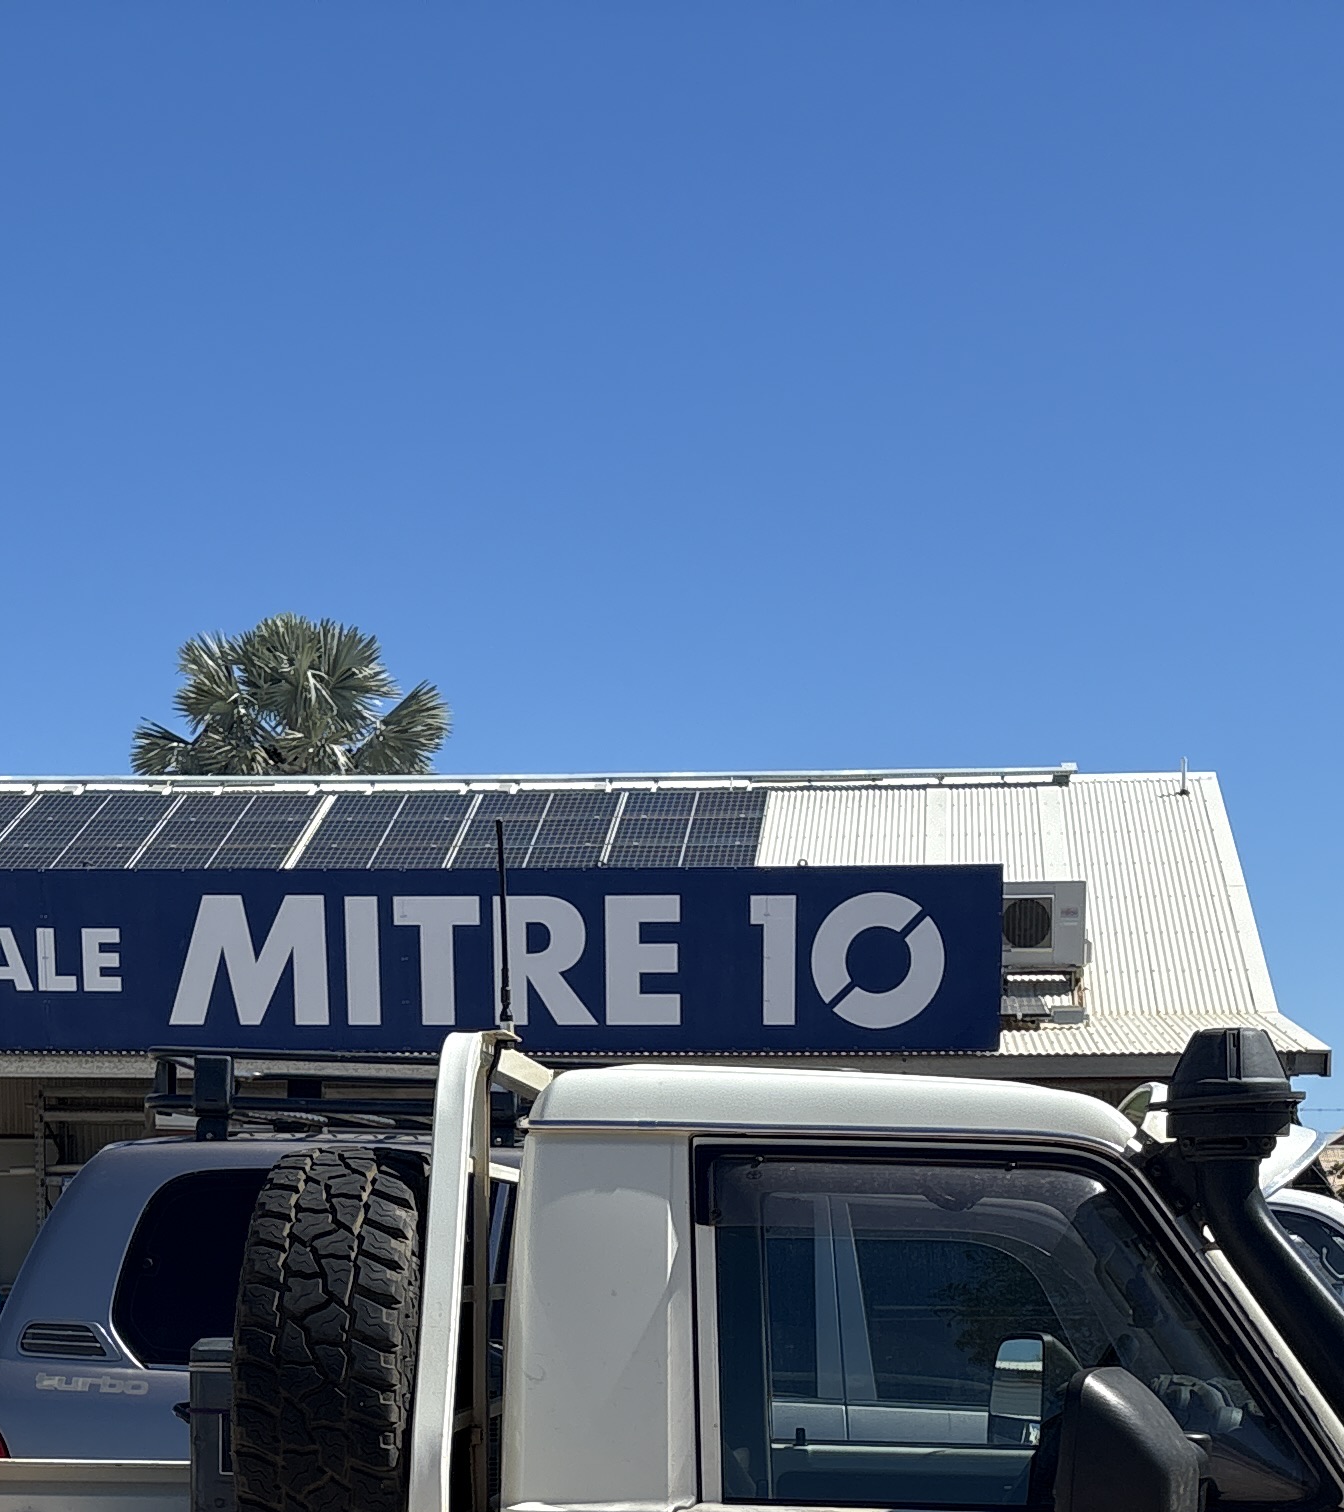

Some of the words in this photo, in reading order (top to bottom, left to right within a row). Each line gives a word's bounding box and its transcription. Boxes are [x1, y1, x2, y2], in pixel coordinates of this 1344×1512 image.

[168, 894, 682, 1026] MITRE
[749, 891, 946, 1029] 10
[35, 1372, 149, 1396] turbo
